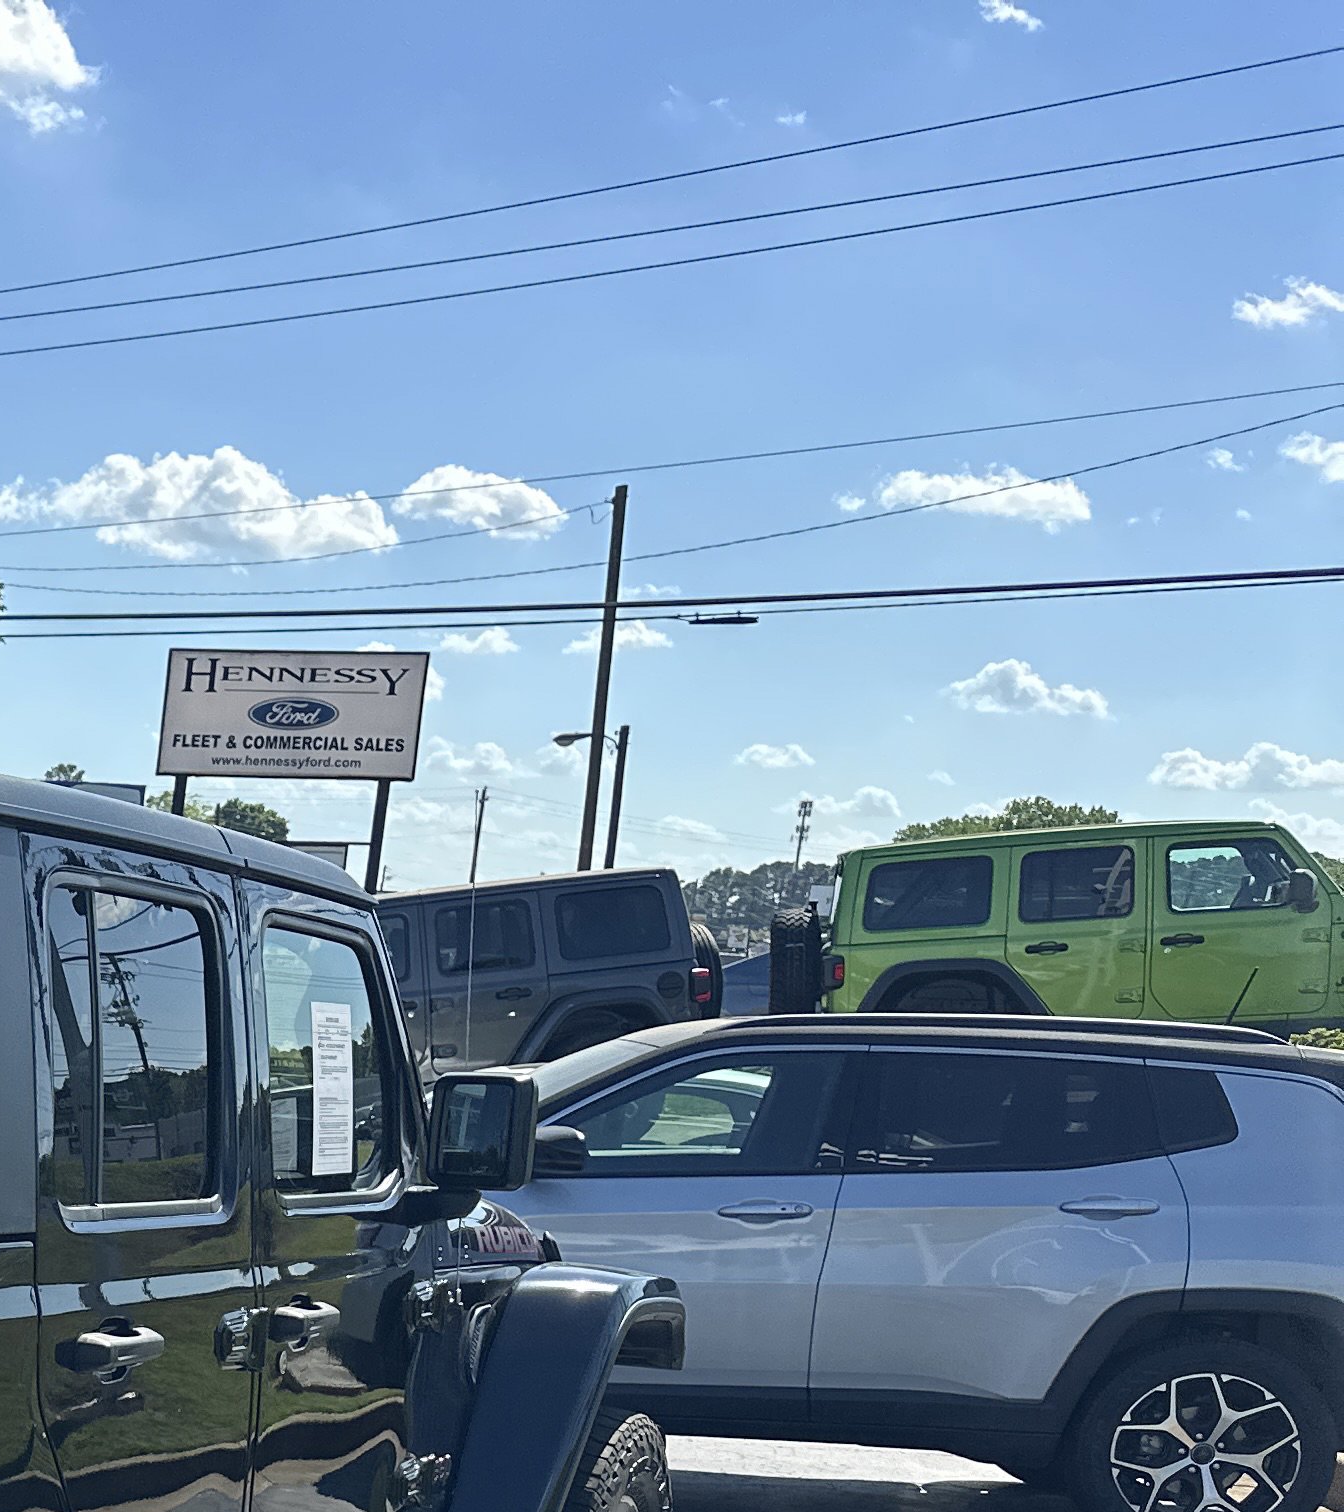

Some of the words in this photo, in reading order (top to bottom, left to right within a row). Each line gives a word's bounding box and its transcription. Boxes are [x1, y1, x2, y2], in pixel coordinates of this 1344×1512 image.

[181, 657, 410, 696] HENNESSY
[265, 702, 320, 726] Ford
[172, 734, 221, 748] FLEET
[226, 735, 237, 749] &
[243, 735, 349, 751] COMMERCIAL
[353, 737, 405, 753] SALES
[211, 755, 362, 770] www.hennessyford.com
